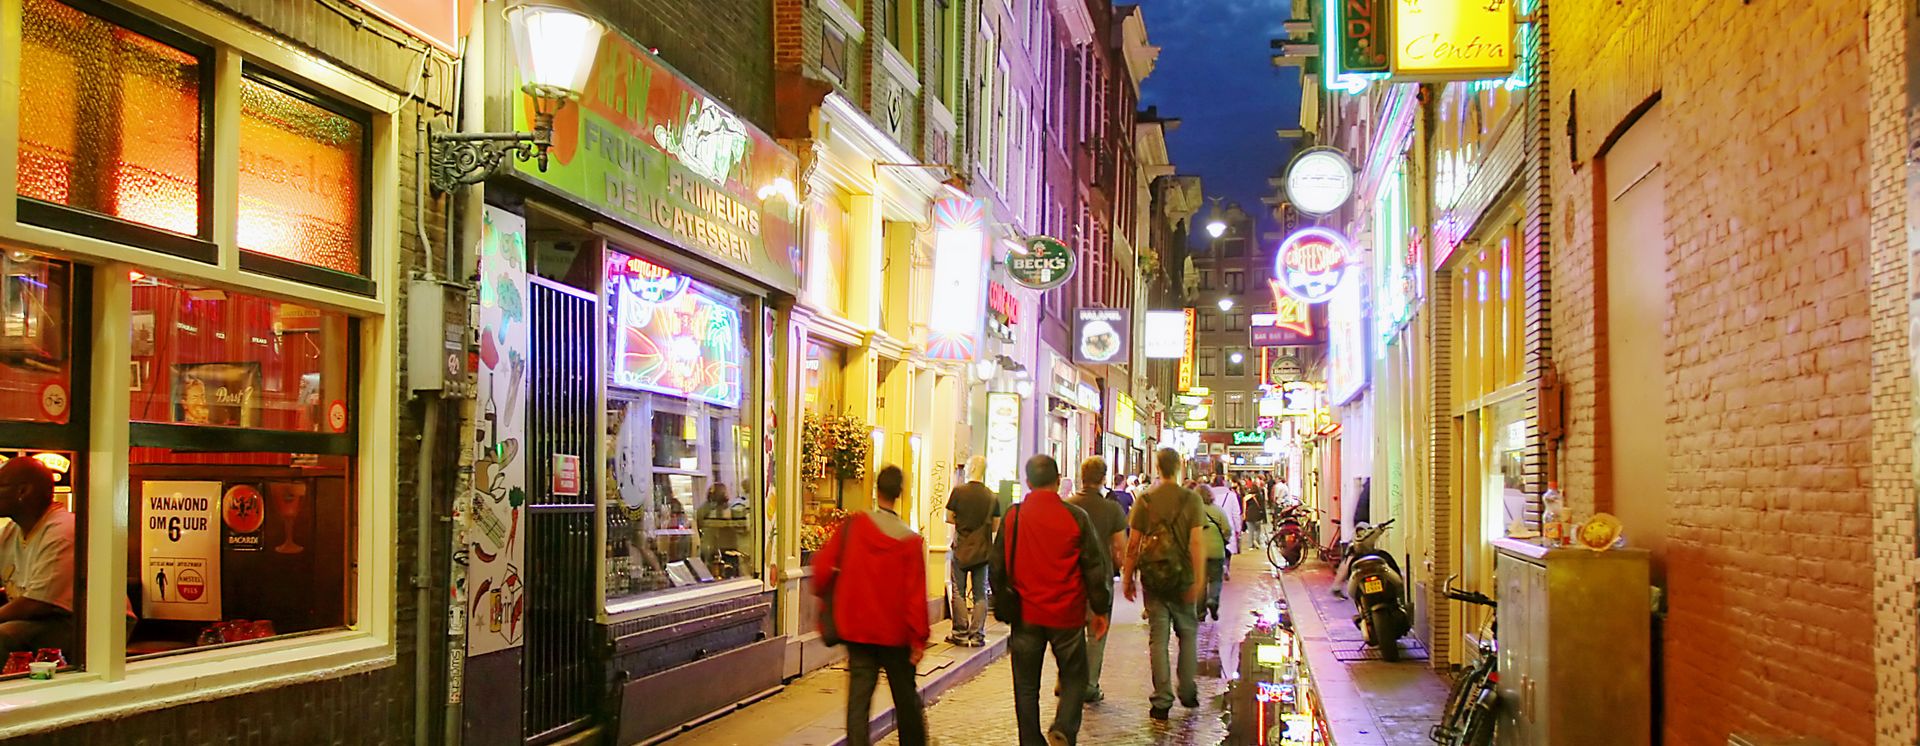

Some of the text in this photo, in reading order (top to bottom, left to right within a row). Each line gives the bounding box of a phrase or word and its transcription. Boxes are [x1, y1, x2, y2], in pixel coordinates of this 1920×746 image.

[1405, 33, 1504, 60] Centra
[585, 117, 653, 180] FRUIT
[667, 165, 760, 236] PRIMEURS
[604, 171, 752, 266] DELICATESSEN
[1013, 257, 1066, 270] BECK'S
[150, 497, 208, 512] VANAVOND
[150, 516, 208, 542] OM 6 UUR
[228, 536, 259, 544] BACARDI
[179, 575, 202, 583] AMSTEL
[183, 586, 199, 595] PILS
